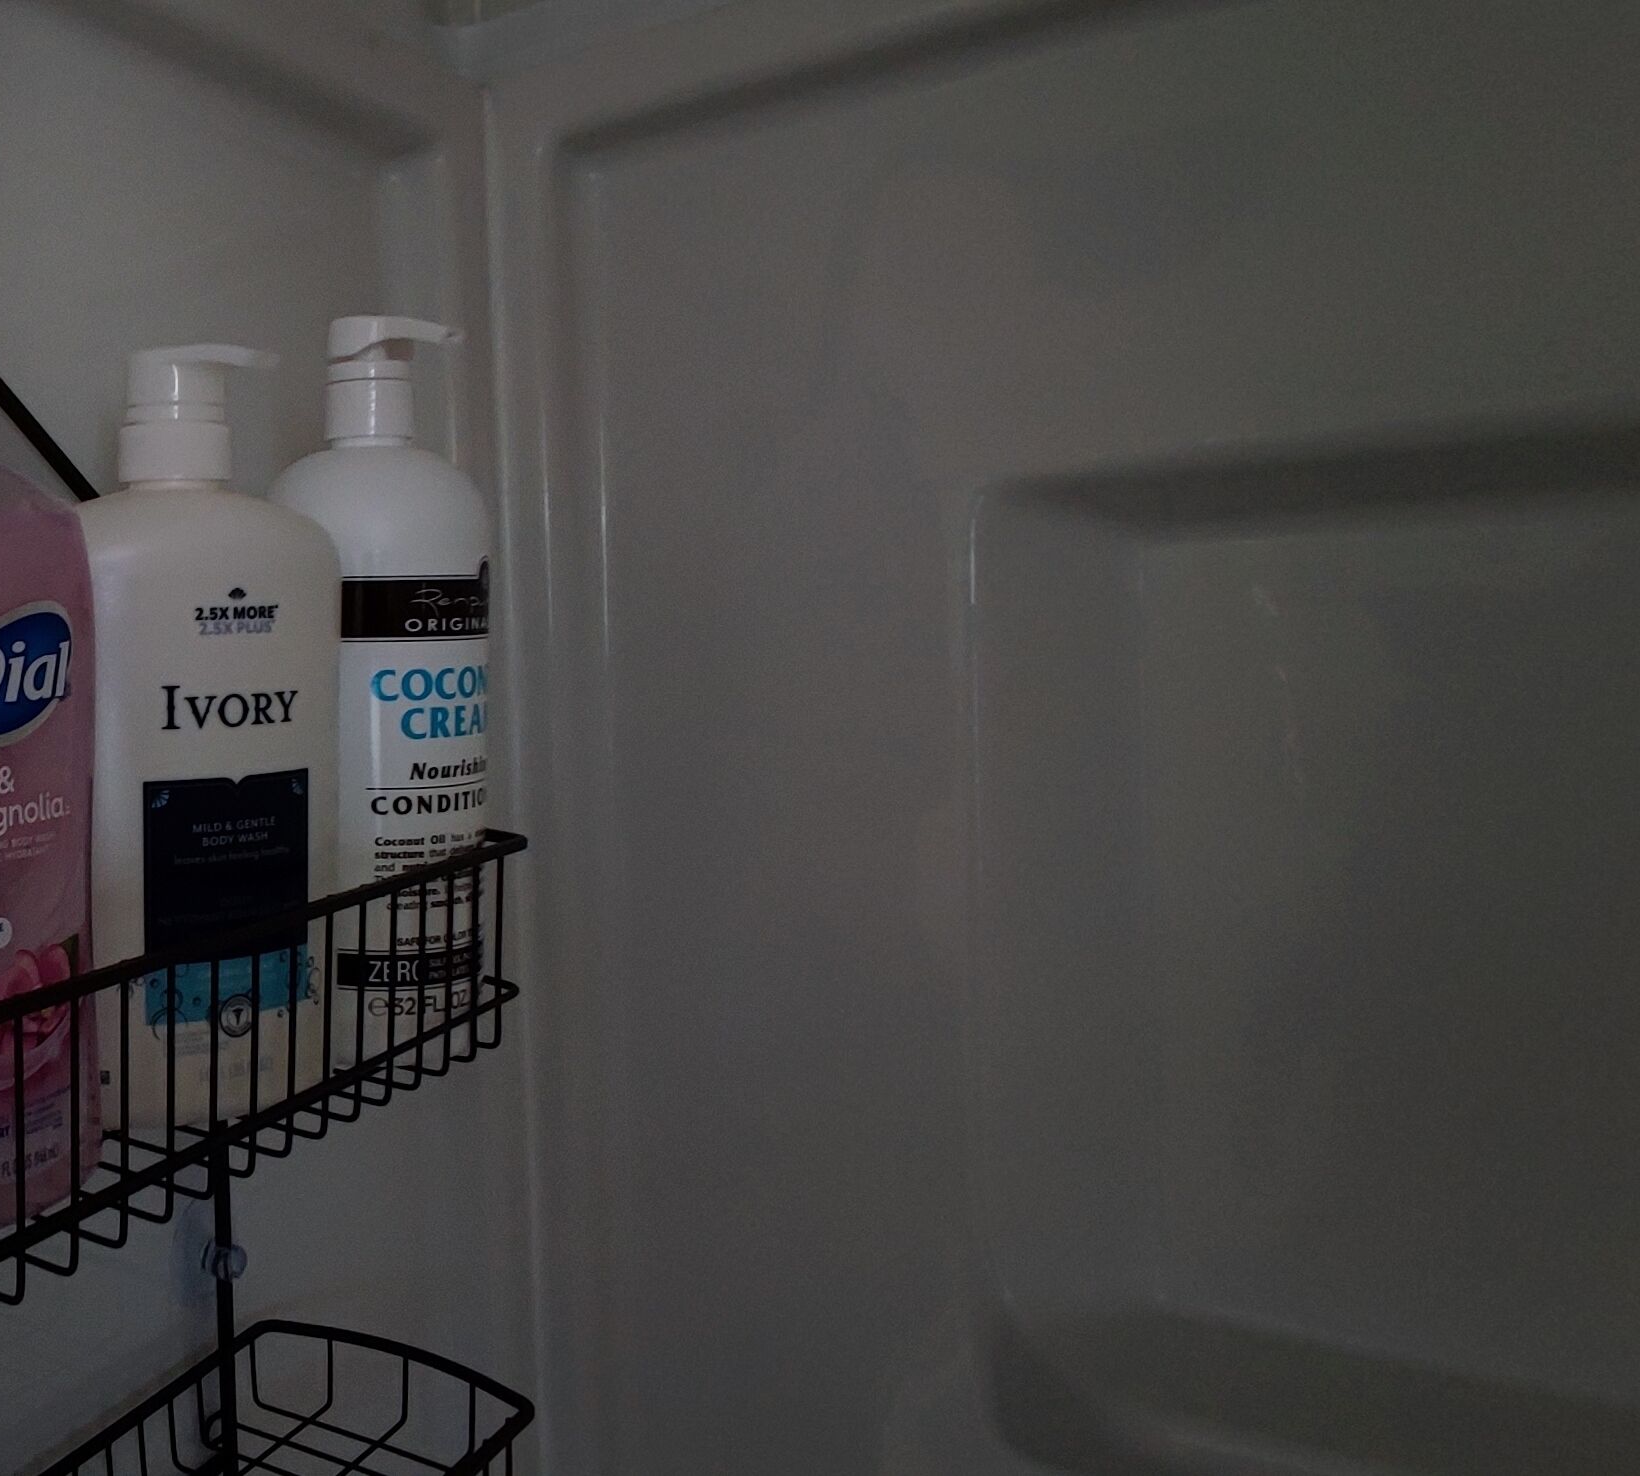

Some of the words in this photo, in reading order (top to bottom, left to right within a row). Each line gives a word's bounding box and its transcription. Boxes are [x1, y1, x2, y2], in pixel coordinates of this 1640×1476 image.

[195, 606, 229, 621] 2.5X
[199, 622, 233, 636] 2.5X
[192, 820, 223, 834] MILD
[236, 814, 278, 831] GENTLE
[201, 833, 234, 848] BODY
[236, 830, 269, 844] WASH
[374, 836, 425, 847] Coconut
